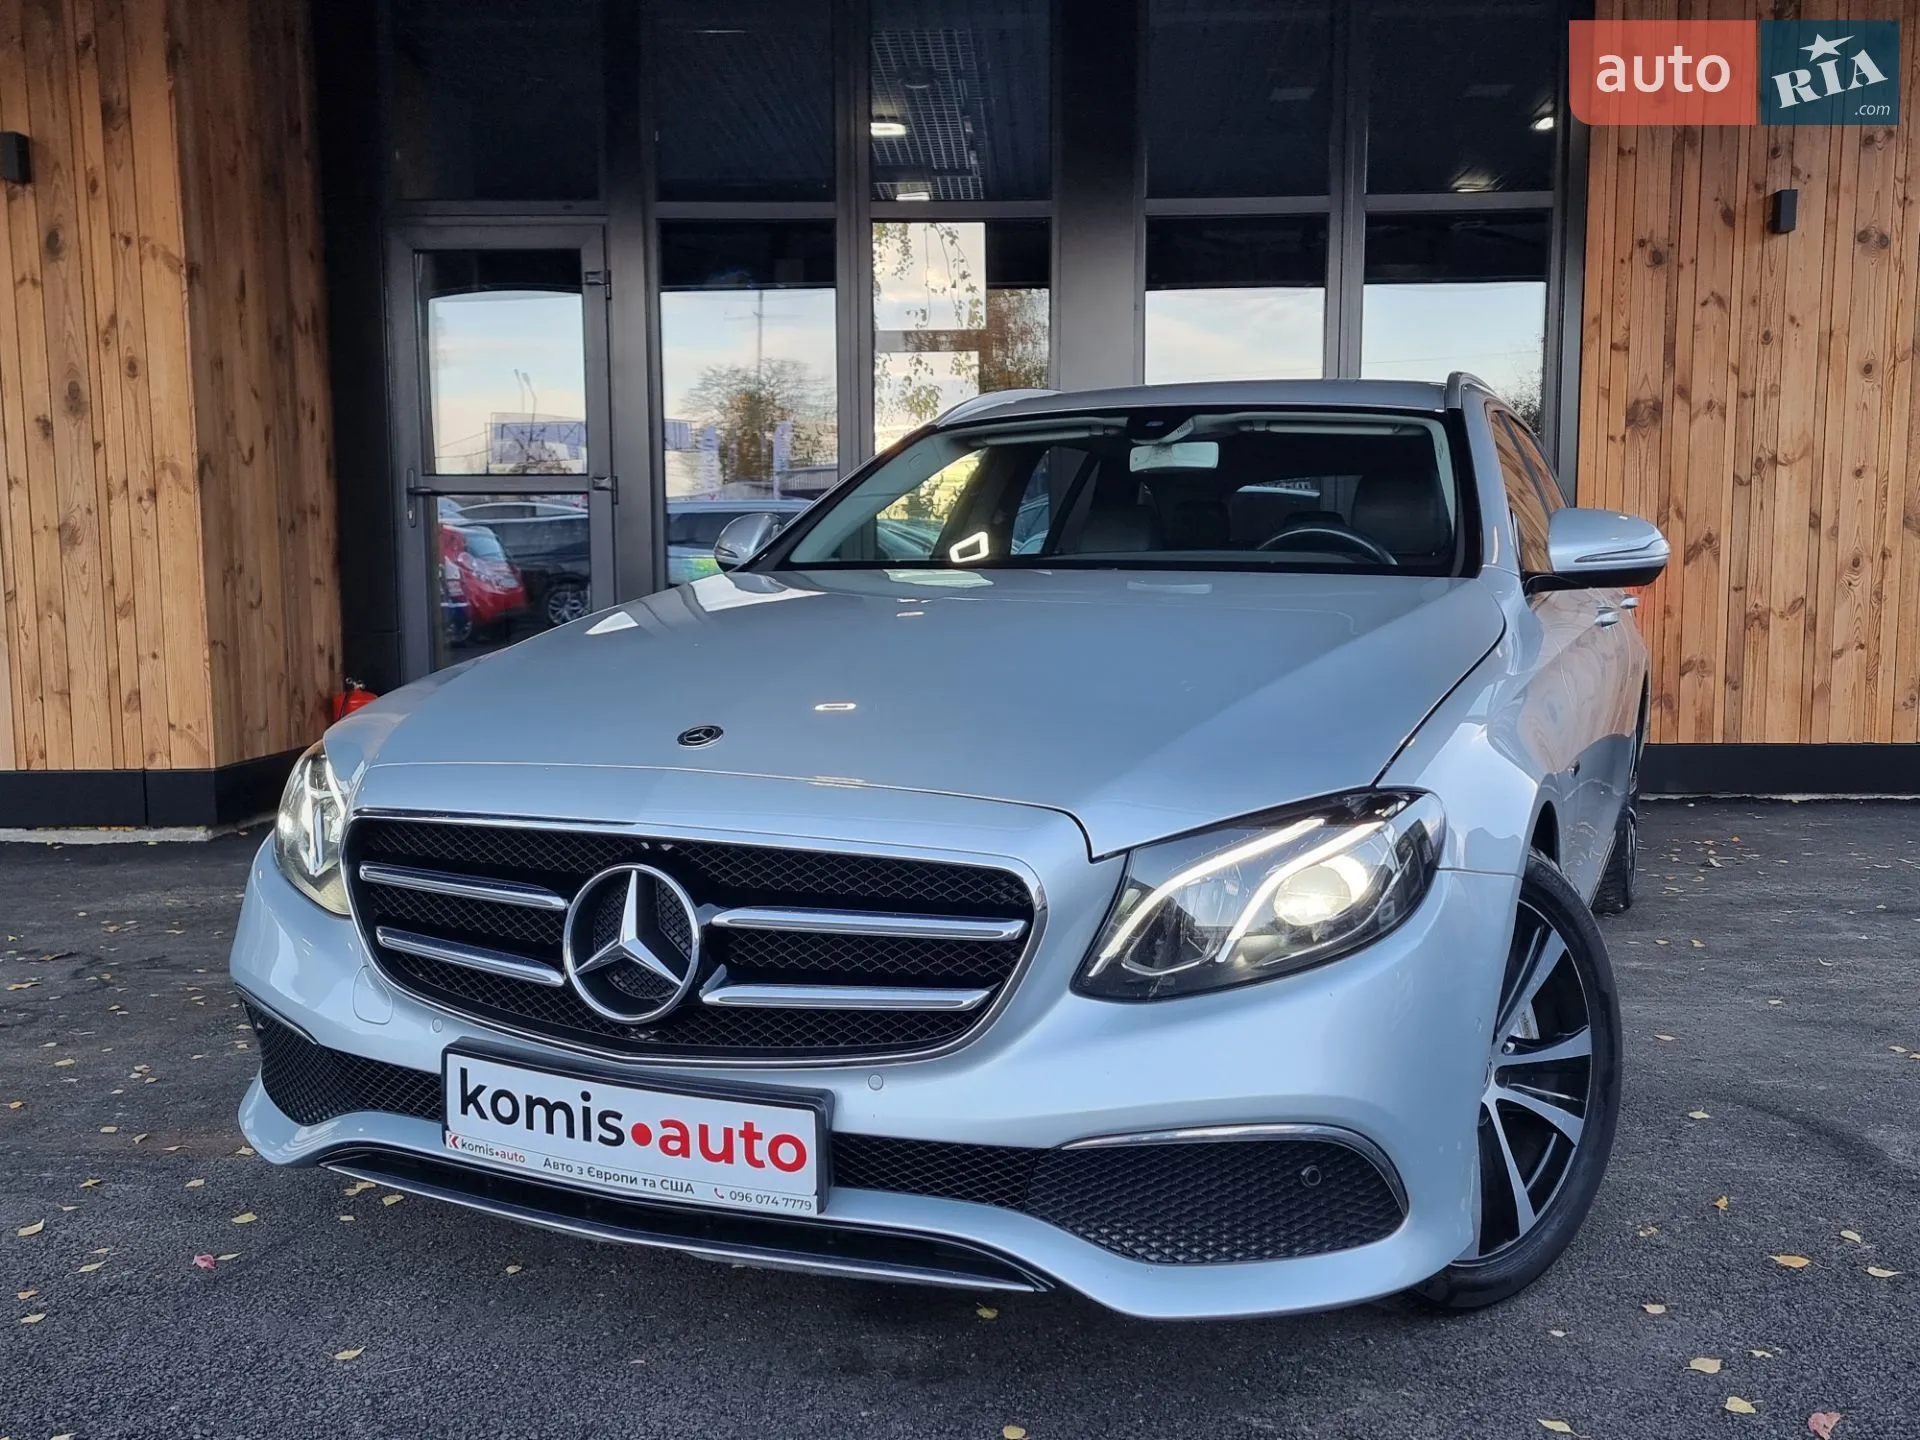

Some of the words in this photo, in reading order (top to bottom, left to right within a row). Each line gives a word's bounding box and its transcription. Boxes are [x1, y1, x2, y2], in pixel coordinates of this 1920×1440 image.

[543, 1157, 573, 1174] Авто
[587, 1166, 638, 1186] Європи
[641, 1177, 656, 1189] та
[660, 1179, 695, 1195] США
[729, 1190, 752, 1203] 096
[755, 1194, 779, 1207] 074
[782, 1197, 812, 1211] 7779
